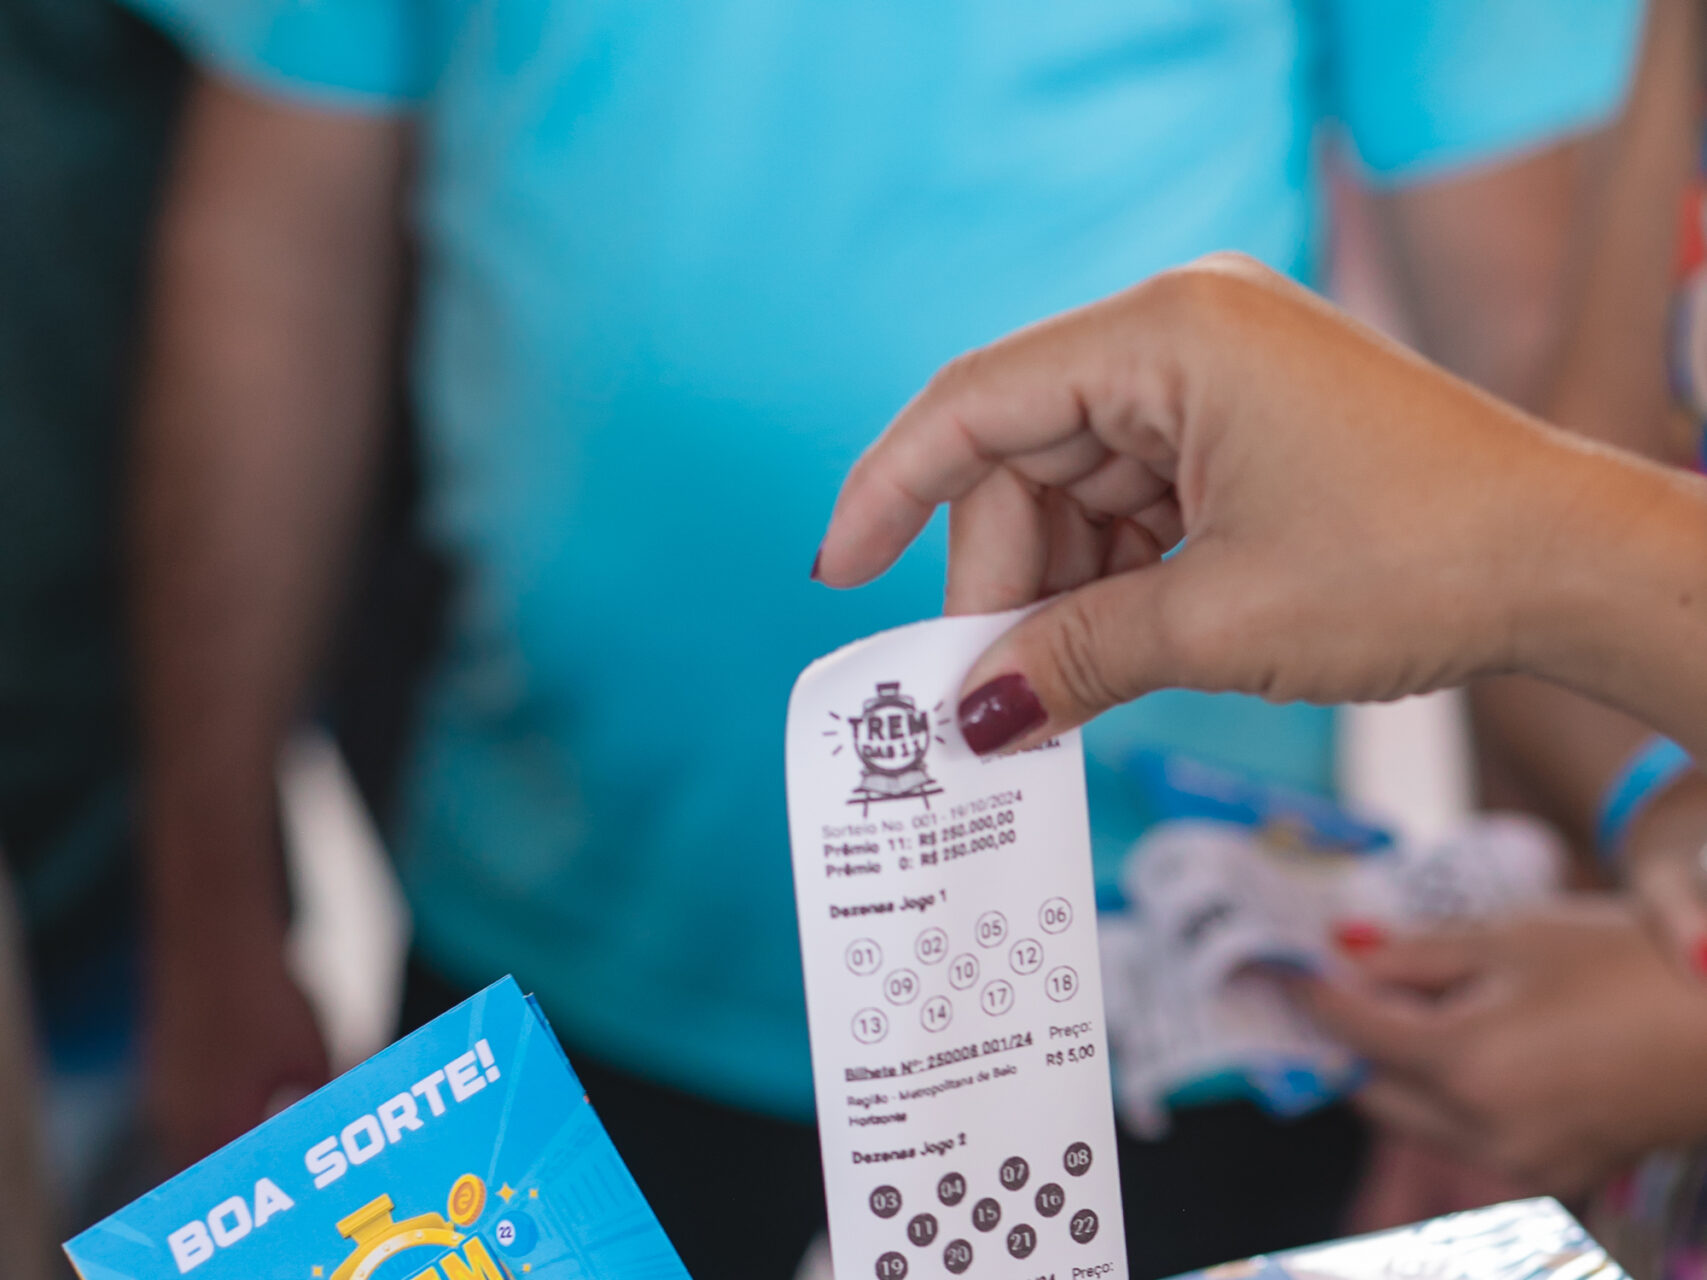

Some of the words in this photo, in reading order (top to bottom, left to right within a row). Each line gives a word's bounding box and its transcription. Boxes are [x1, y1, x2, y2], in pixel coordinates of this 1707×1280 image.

[848, 711, 929, 741] TREM
[822, 823, 877, 839] Sorteio
[912, 813, 937, 829] 001
[823, 842, 880, 858] Prêmio
[918, 831, 937, 846] R$
[941, 810, 1015, 842] 250.000,00
[825, 861, 882, 877] Prêmio
[920, 850, 938, 865] R$
[943, 829, 1017, 861] 250.000,00
[829, 901, 894, 919] Dezenas
[899, 894, 935, 911] Jogo
[939, 888, 947, 902] 1
[852, 949, 874, 966] 01
[921, 936, 942, 956] 02
[980, 920, 1002, 940] 05
[1044, 907, 1066, 925] 06
[890, 977, 913, 996] 09
[955, 962, 974, 981] 10
[1015, 947, 1037, 966] 12
[859, 1019, 881, 1036] 13
[927, 1004, 946, 1024] 14
[988, 988, 1008, 1007] 17
[1052, 974, 1072, 993] 18
[1049, 1021, 1093, 1039] Preço:
[844, 1065, 897, 1082] Bilhete
[1046, 1051, 1064, 1067] R$
[1068, 1043, 1095, 1064] 5,00
[847, 1094, 888, 1109] Região
[899, 1075, 974, 1101] Metropolitana
[976, 1071, 991, 1083] de
[167, 1177, 295, 1275] BOA
[304, 1038, 501, 1190] SORTE!
[852, 1147, 916, 1164] Dezenas
[920, 1140, 955, 1157] Jogo
[872, 1192, 898, 1210] 03
[941, 1179, 963, 1199] 04
[1002, 1163, 1025, 1183] 07
[1066, 1148, 1089, 1168] 08
[499, 1226, 513, 1239] 22
[911, 1220, 932, 1239] 11
[977, 1205, 998, 1223] 15
[1041, 1191, 1062, 1209] 16
[881, 1258, 904, 1276] 19
[947, 1246, 970, 1265] 20
[1010, 1231, 1032, 1251] 21
[1072, 1216, 1095, 1236] 22
[1072, 1262, 1114, 1280] Preço:
